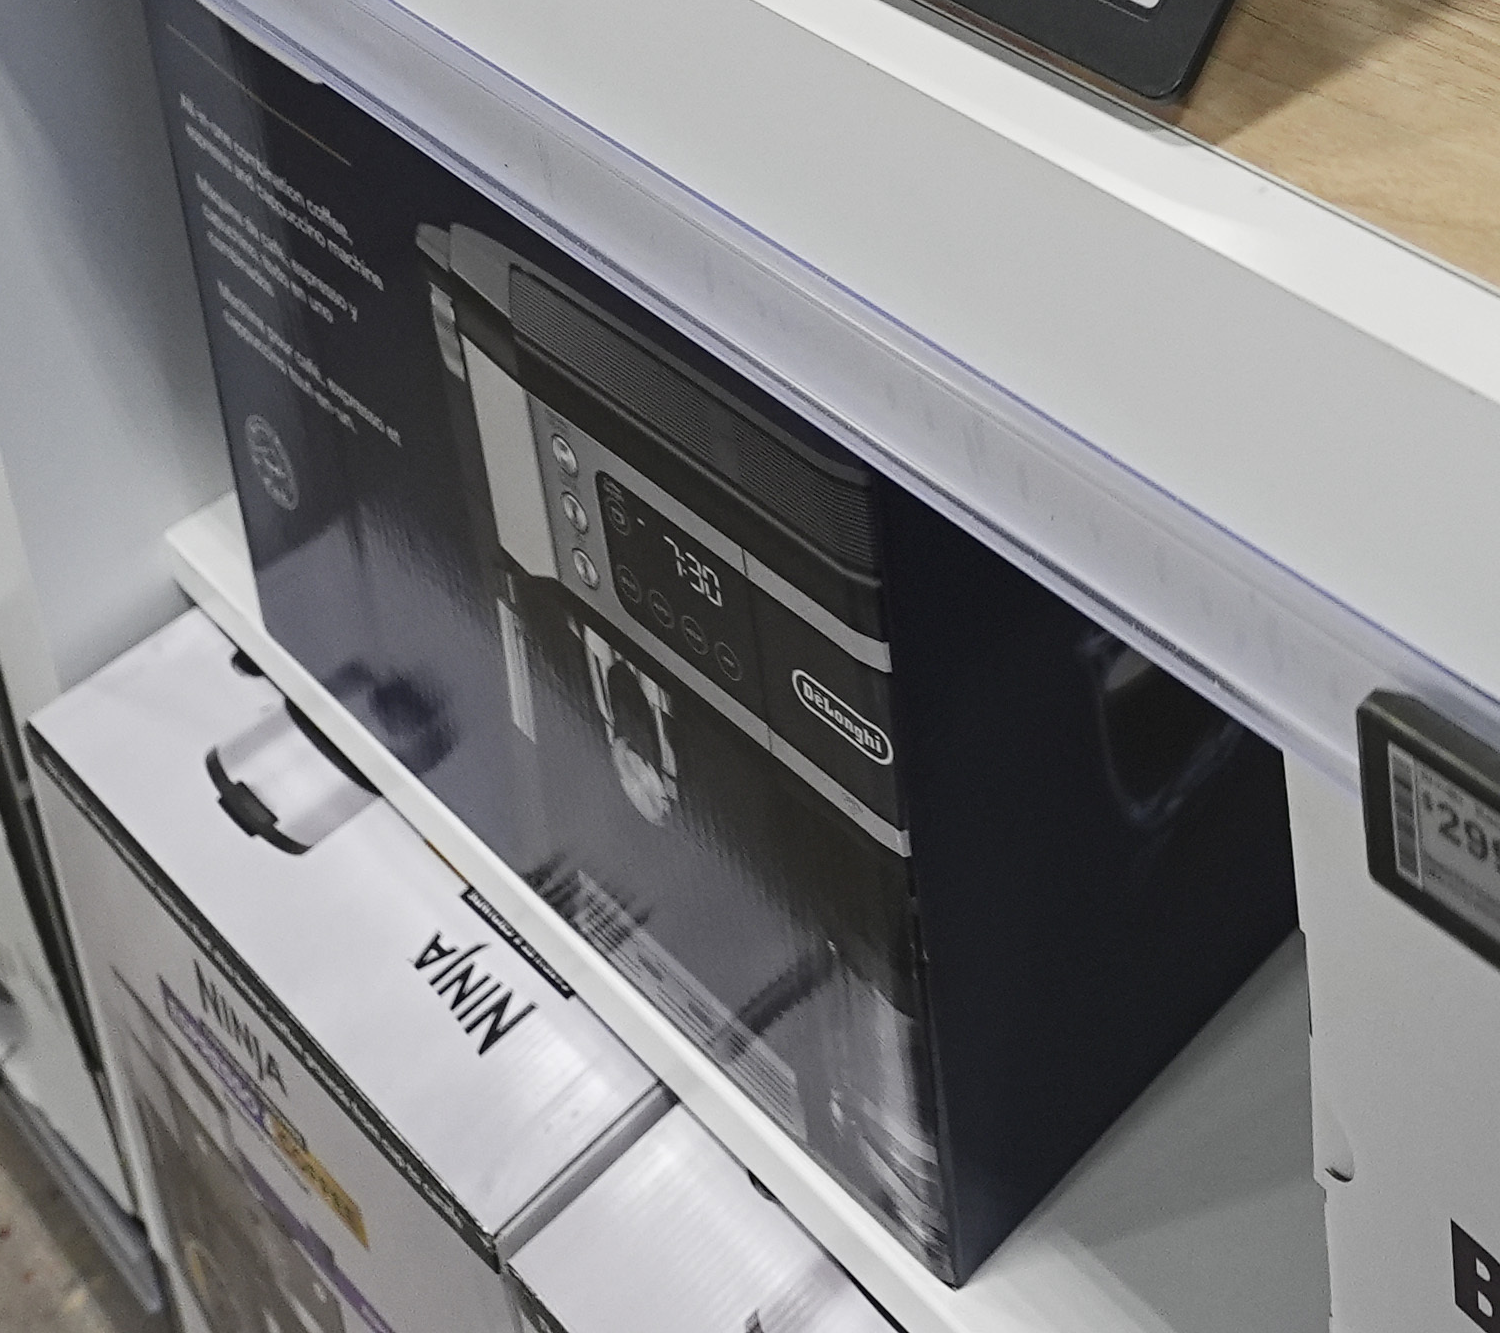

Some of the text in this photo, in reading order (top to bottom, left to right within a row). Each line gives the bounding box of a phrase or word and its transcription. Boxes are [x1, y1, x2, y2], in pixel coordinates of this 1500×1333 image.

[664, 535, 722, 608] 7:30
[194, 957, 287, 1098] NINJA
[414, 931, 538, 1057] NINJA
